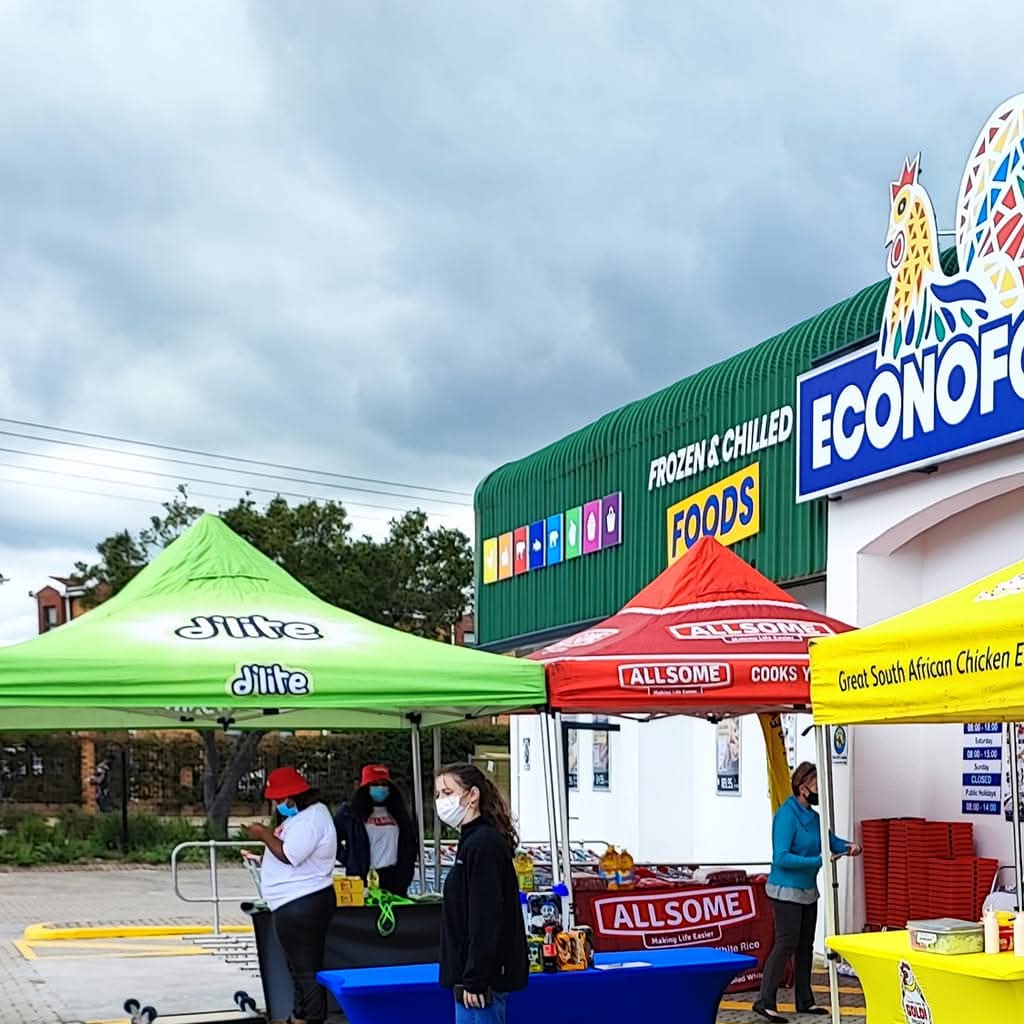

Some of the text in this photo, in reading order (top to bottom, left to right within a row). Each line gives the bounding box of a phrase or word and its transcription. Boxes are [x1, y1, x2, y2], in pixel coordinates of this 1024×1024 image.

[648, 405, 793, 491] FROZEN & CHILLED
[672, 476, 754, 558] FOODS
[691, 622, 816, 636] ALLSOME
[630, 665, 720, 685] ALLSOME
[751, 666, 811, 682] COOKS Y
[838, 670, 869, 692] Great
[870, 660, 905, 687] South
[908, 656, 952, 681] African
[956, 646, 1009, 674] Chicken
[232, 663, 310, 696] d'lite
[971, 775, 992, 784] CLOSED
[613, 892, 742, 929] ALLSOME
[651, 931, 714, 945] Making Life Easier
[906, 1004, 927, 1019] GOLDI
